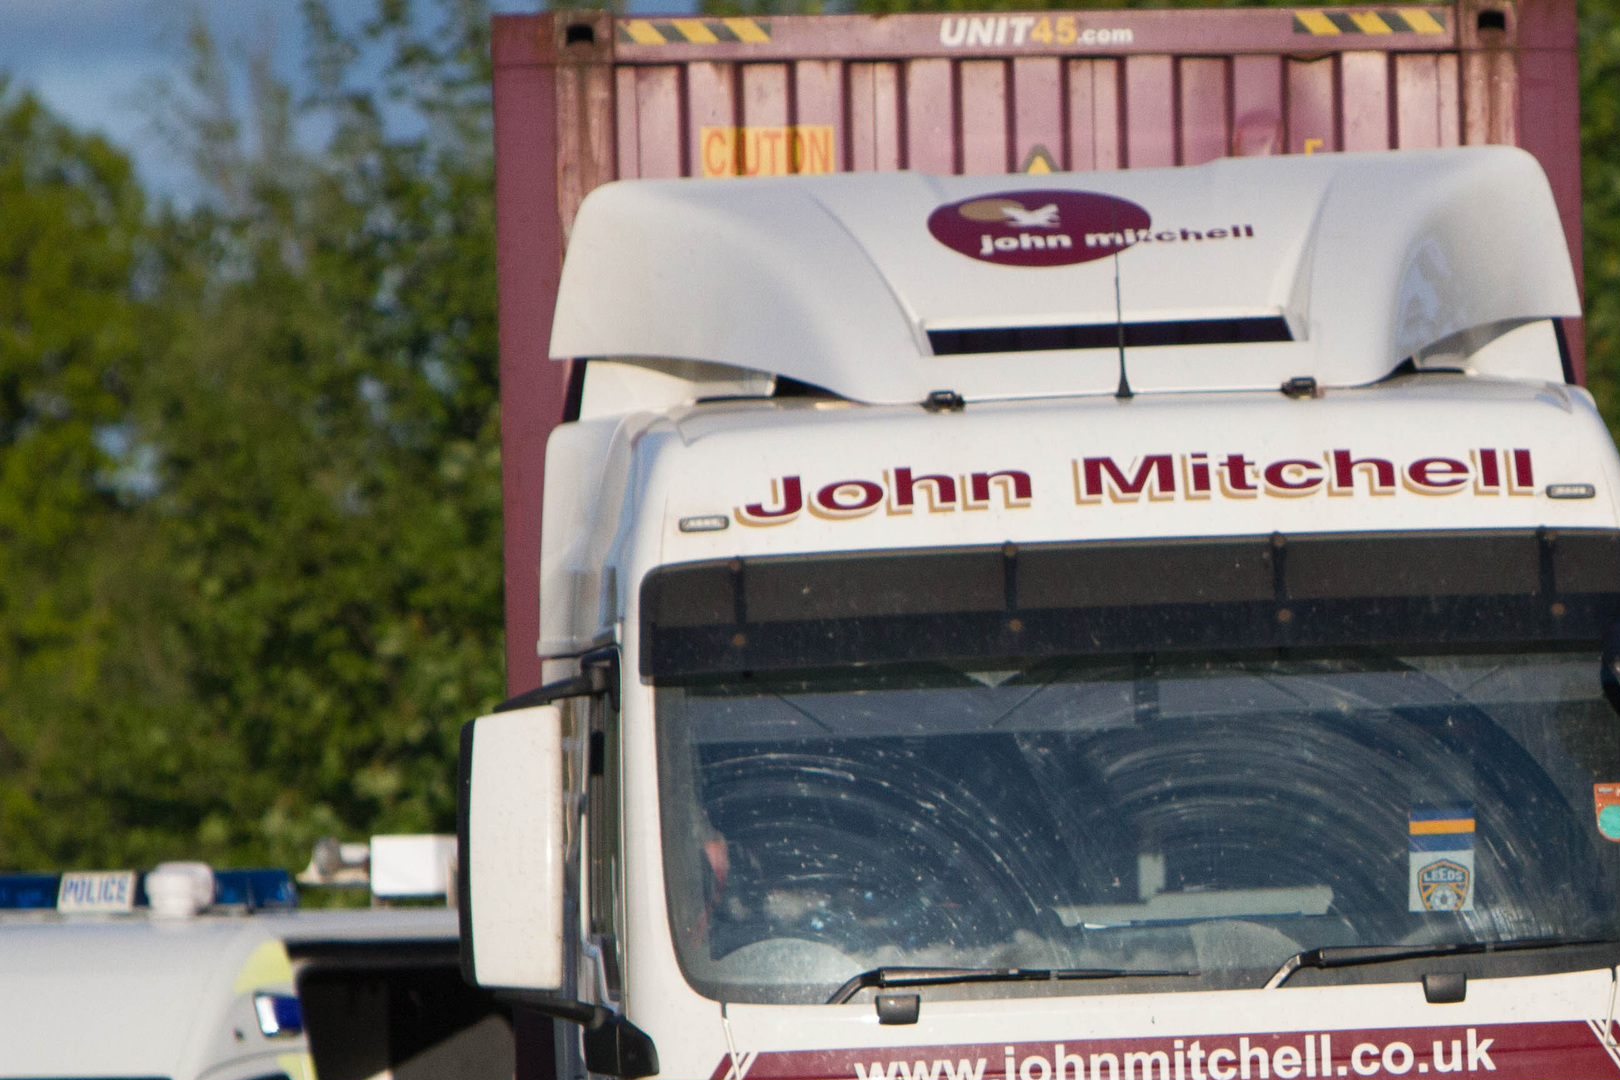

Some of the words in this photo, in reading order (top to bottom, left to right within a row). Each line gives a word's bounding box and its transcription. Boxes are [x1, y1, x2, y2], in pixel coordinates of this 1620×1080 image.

[940, 15, 1134, 47] UNIT45.com
[980, 233, 1072, 255] john
[1084, 224, 1255, 248] mitchell
[734, 466, 1032, 528] John
[1072, 449, 1536, 506] Mitchell
[61, 876, 128, 905] POLICE
